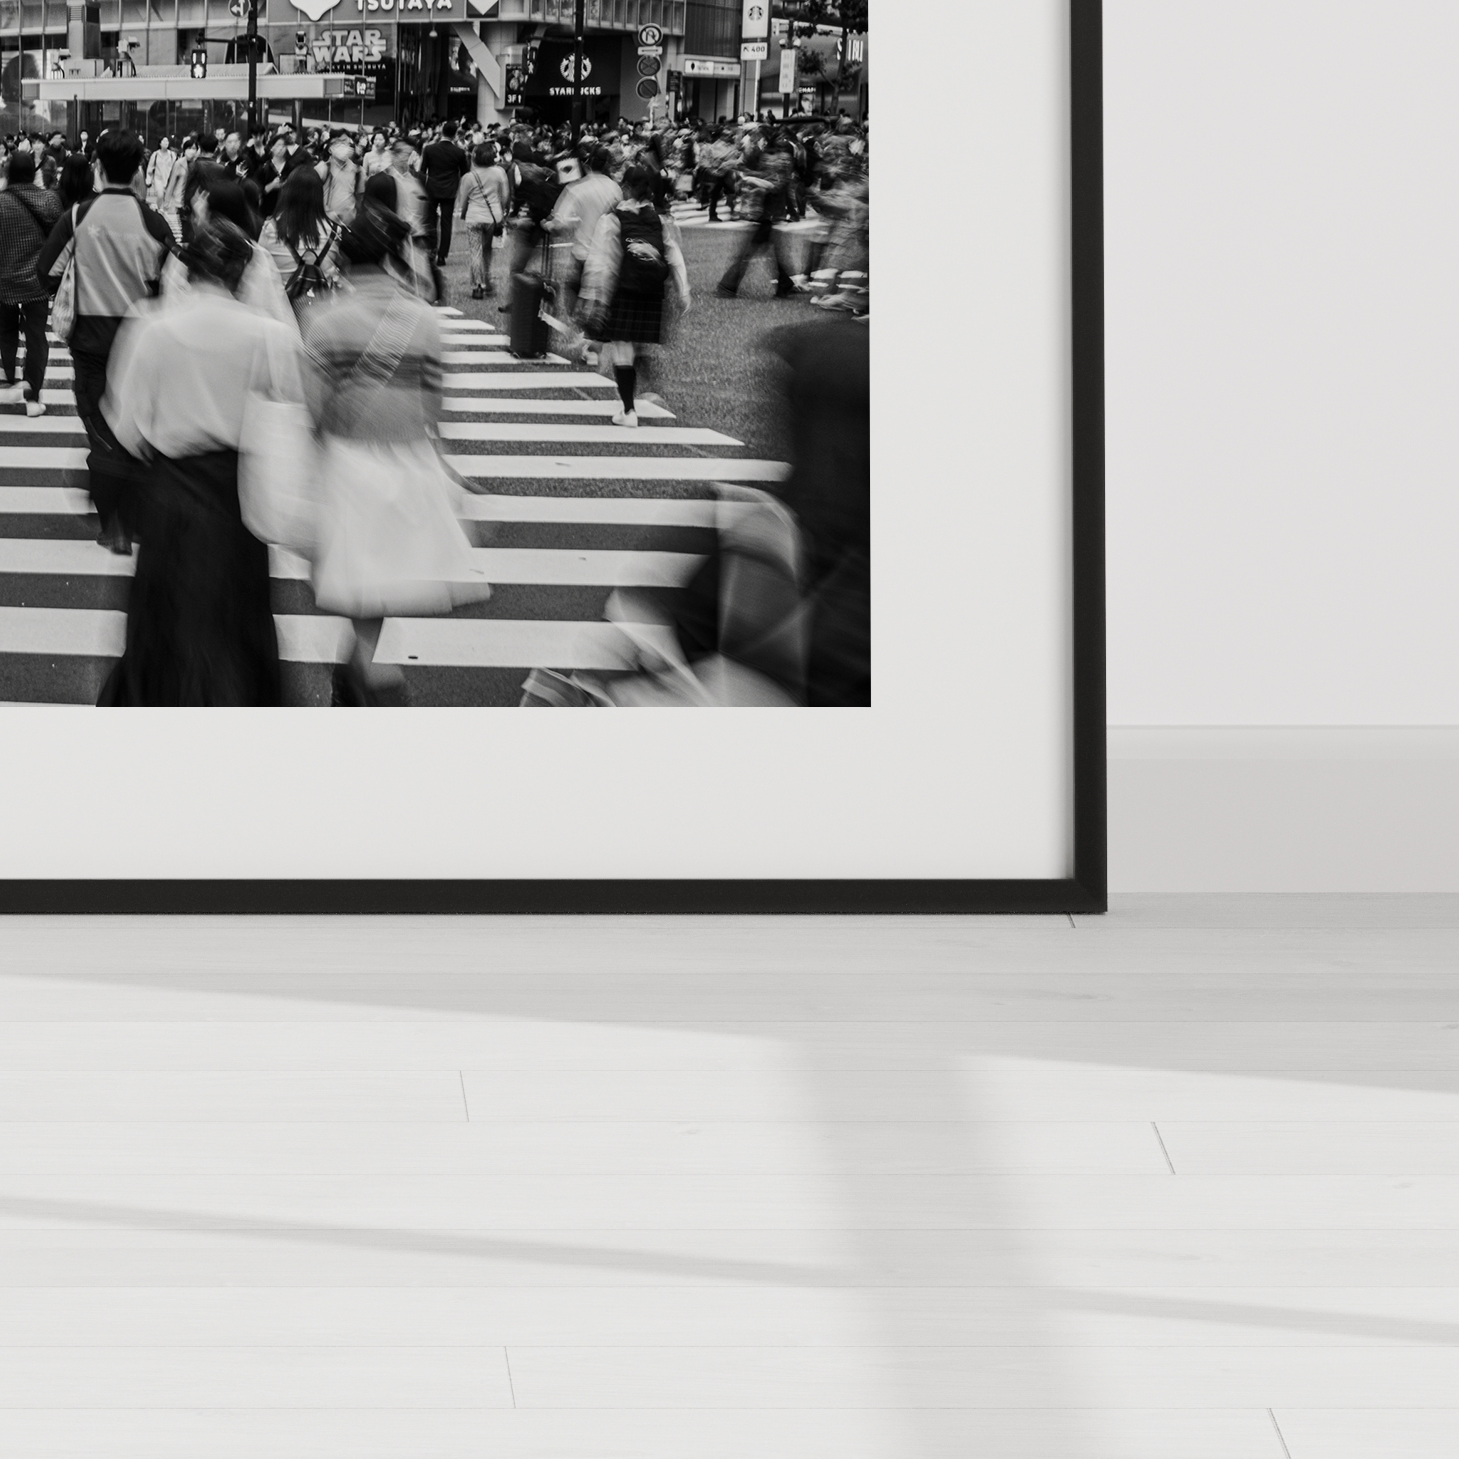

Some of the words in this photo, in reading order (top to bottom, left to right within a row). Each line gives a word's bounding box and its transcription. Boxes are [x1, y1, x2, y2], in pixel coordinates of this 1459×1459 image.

[312, 29, 387, 46] STAR
[312, 45, 387, 63] WARS
[549, 86, 602, 96] STACKS
